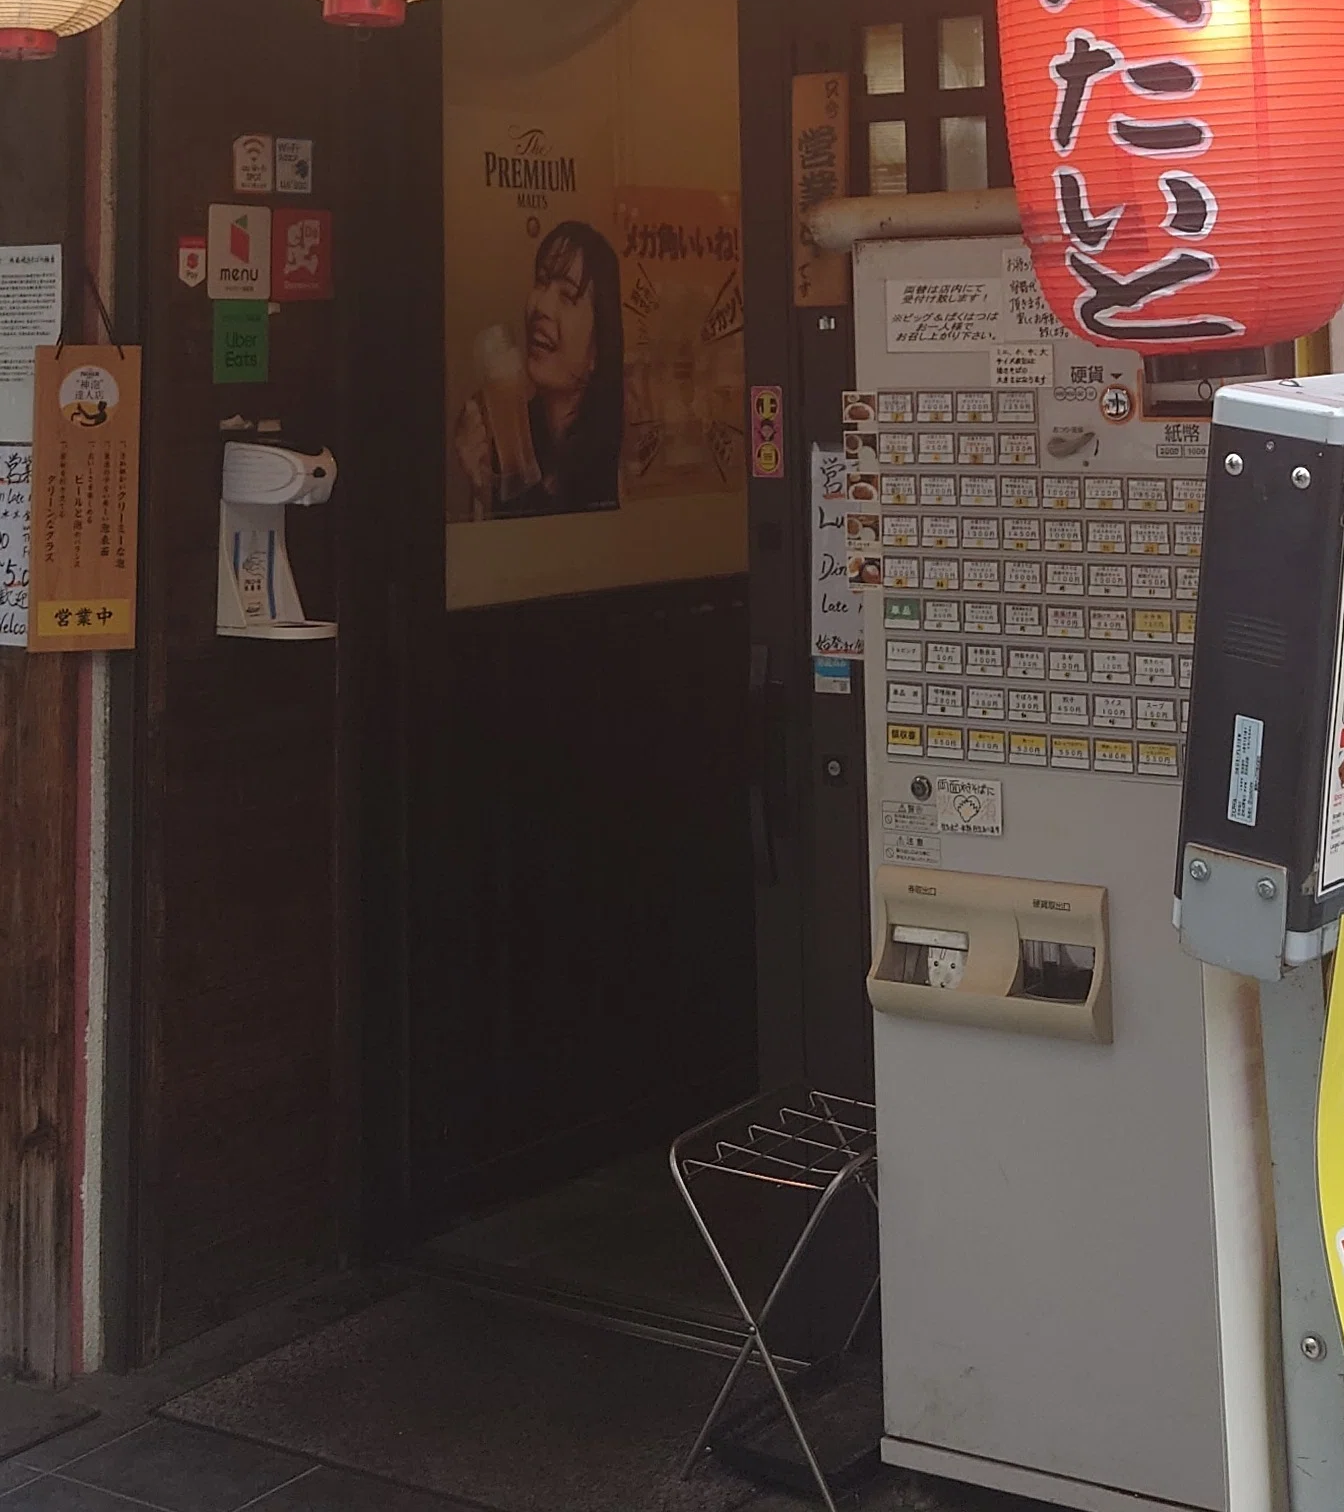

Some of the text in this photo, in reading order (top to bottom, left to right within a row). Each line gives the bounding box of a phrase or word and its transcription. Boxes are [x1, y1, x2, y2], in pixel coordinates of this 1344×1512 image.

[508, 124, 553, 156] The
[484, 151, 577, 192] PREMIUM
[220, 268, 259, 281] menu
[903, 284, 985, 294] 両替は店内にて
[916, 322, 974, 331] お一人様で
[225, 331, 258, 348] Uber
[225, 352, 258, 368] Eats
[1071, 366, 1104, 384] 硬貨
[1164, 424, 1200, 442] 紙幣
[7, 489, 24, 504] Late
[822, 592, 849, 613] Late
[54, 606, 113, 628] 営業中
